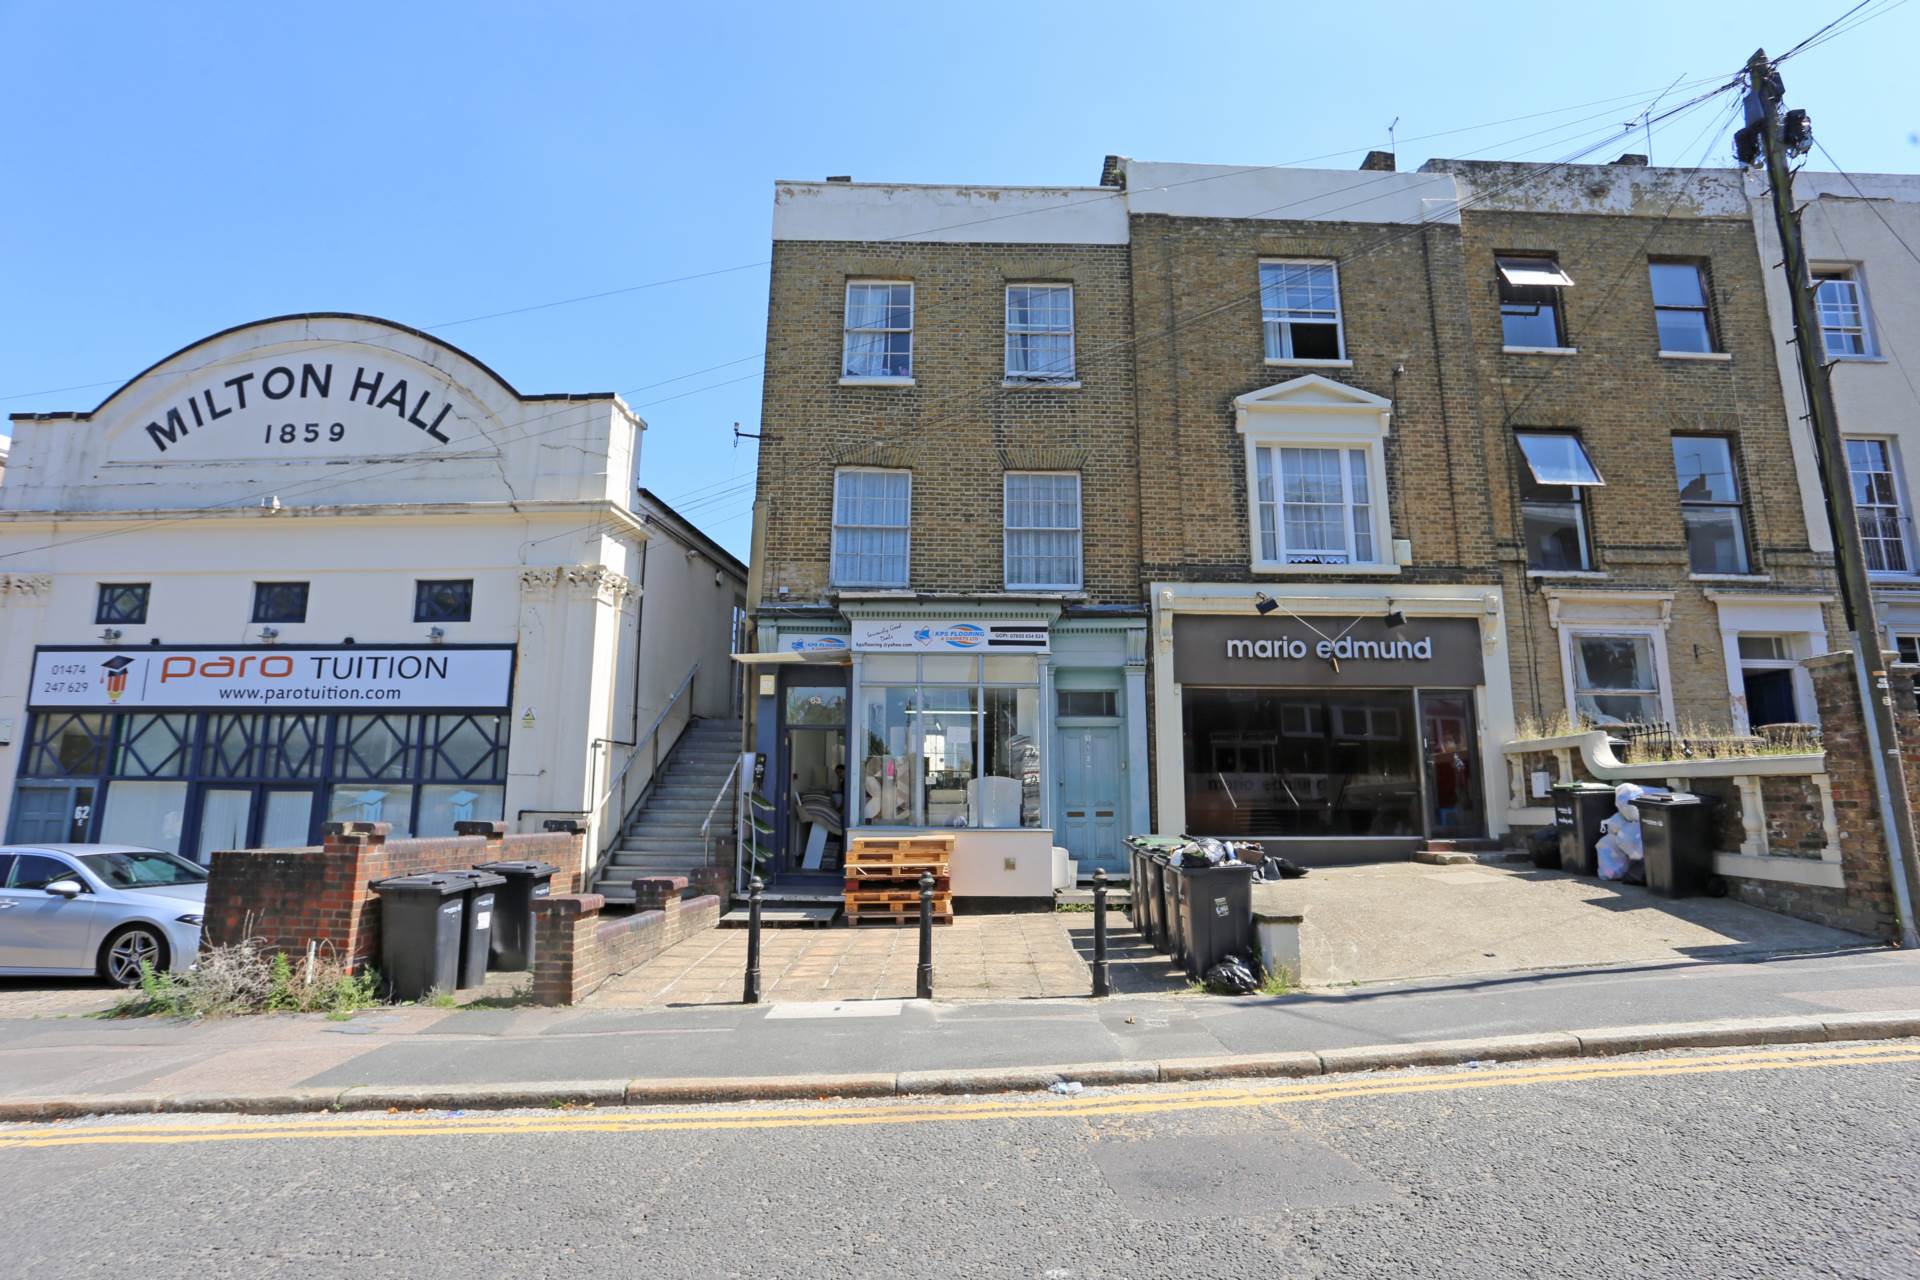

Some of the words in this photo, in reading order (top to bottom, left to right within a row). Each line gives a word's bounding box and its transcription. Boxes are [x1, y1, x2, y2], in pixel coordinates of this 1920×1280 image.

[145, 363, 333, 452] MILTON
[349, 367, 453, 445] HALL
[265, 423, 345, 444] 1859
[1226, 636, 1307, 659] mario
[1315, 636, 1432, 659] edmund
[51, 664, 87, 676] 01474
[160, 655, 294, 683] paro
[310, 655, 449, 680] TUITION
[43, 681, 66, 694] 247
[66, 682, 88, 693] 629
[219, 685, 402, 704] www.parotuition.com
[74, 805, 91, 820] 62
